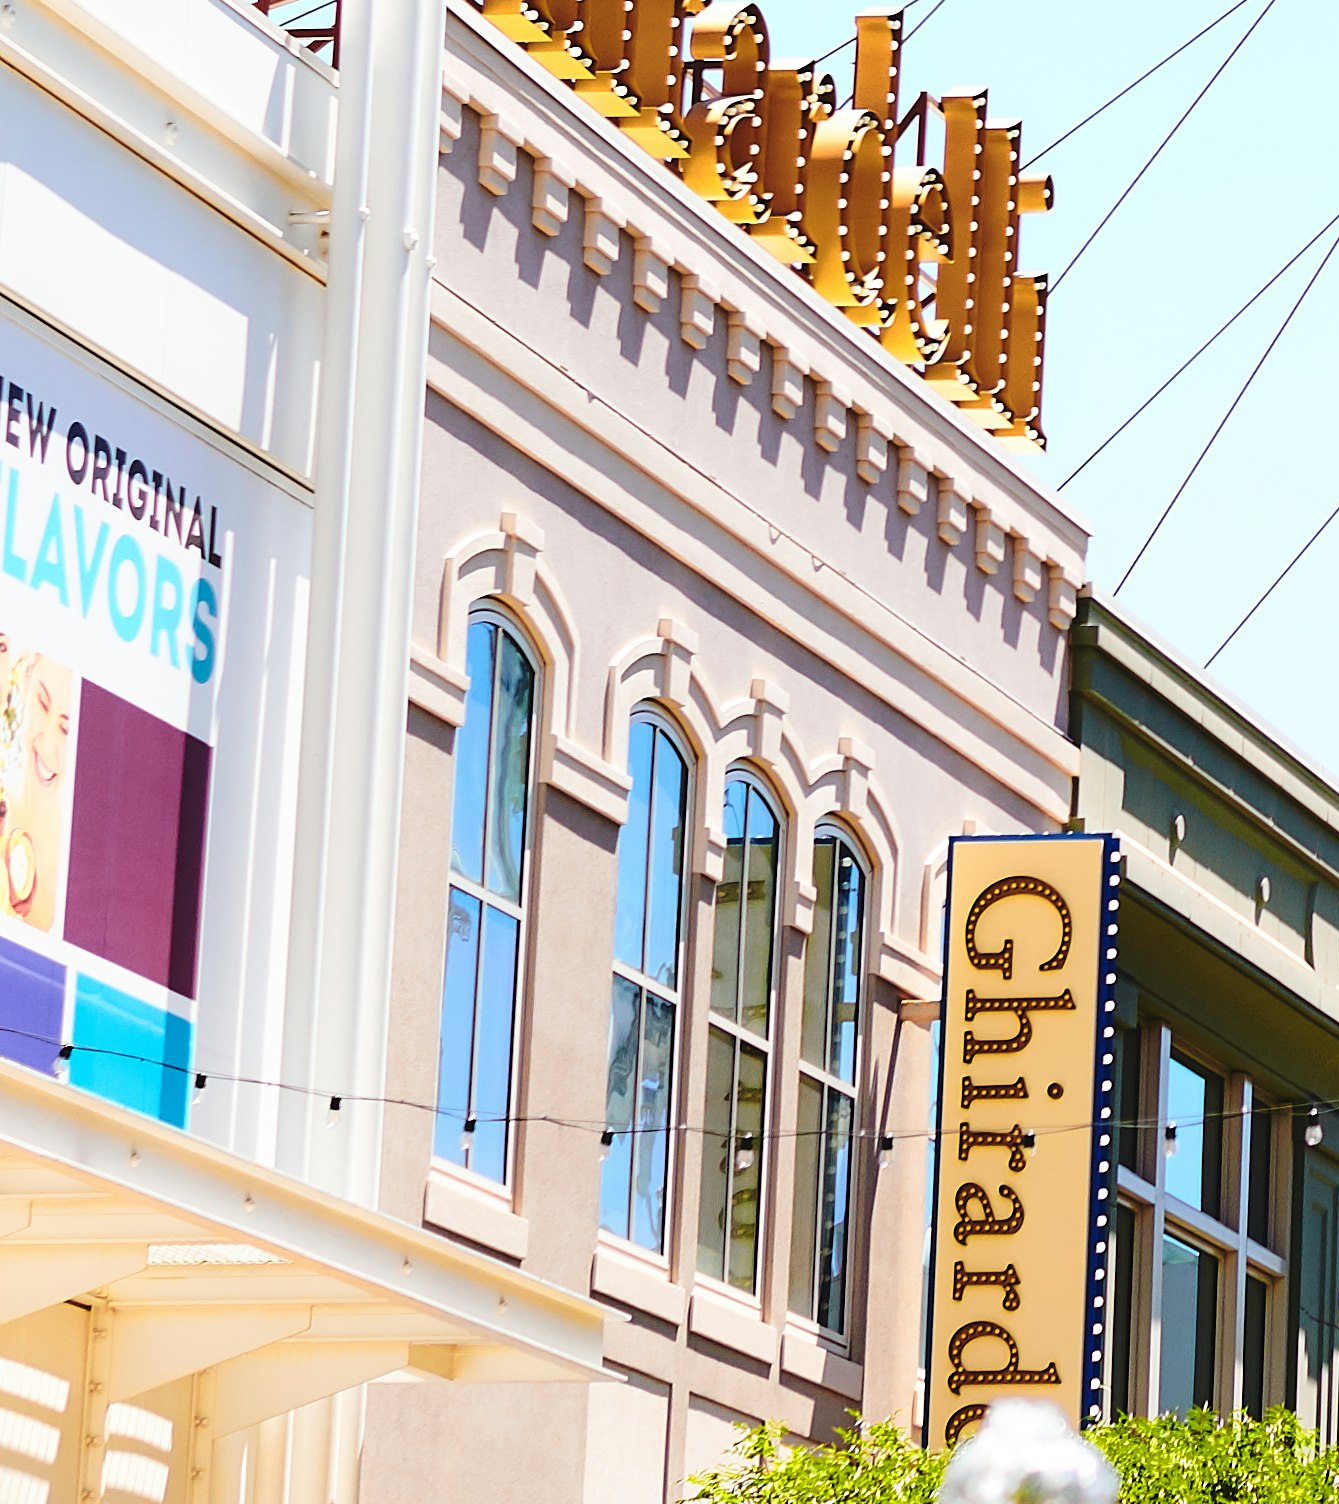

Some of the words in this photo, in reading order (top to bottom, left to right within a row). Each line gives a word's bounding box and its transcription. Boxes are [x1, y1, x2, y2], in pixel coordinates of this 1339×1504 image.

[0, 375, 57, 464] EW
[66, 420, 222, 569] ORIGINAL
[0, 464, 218, 685] LAVORS
